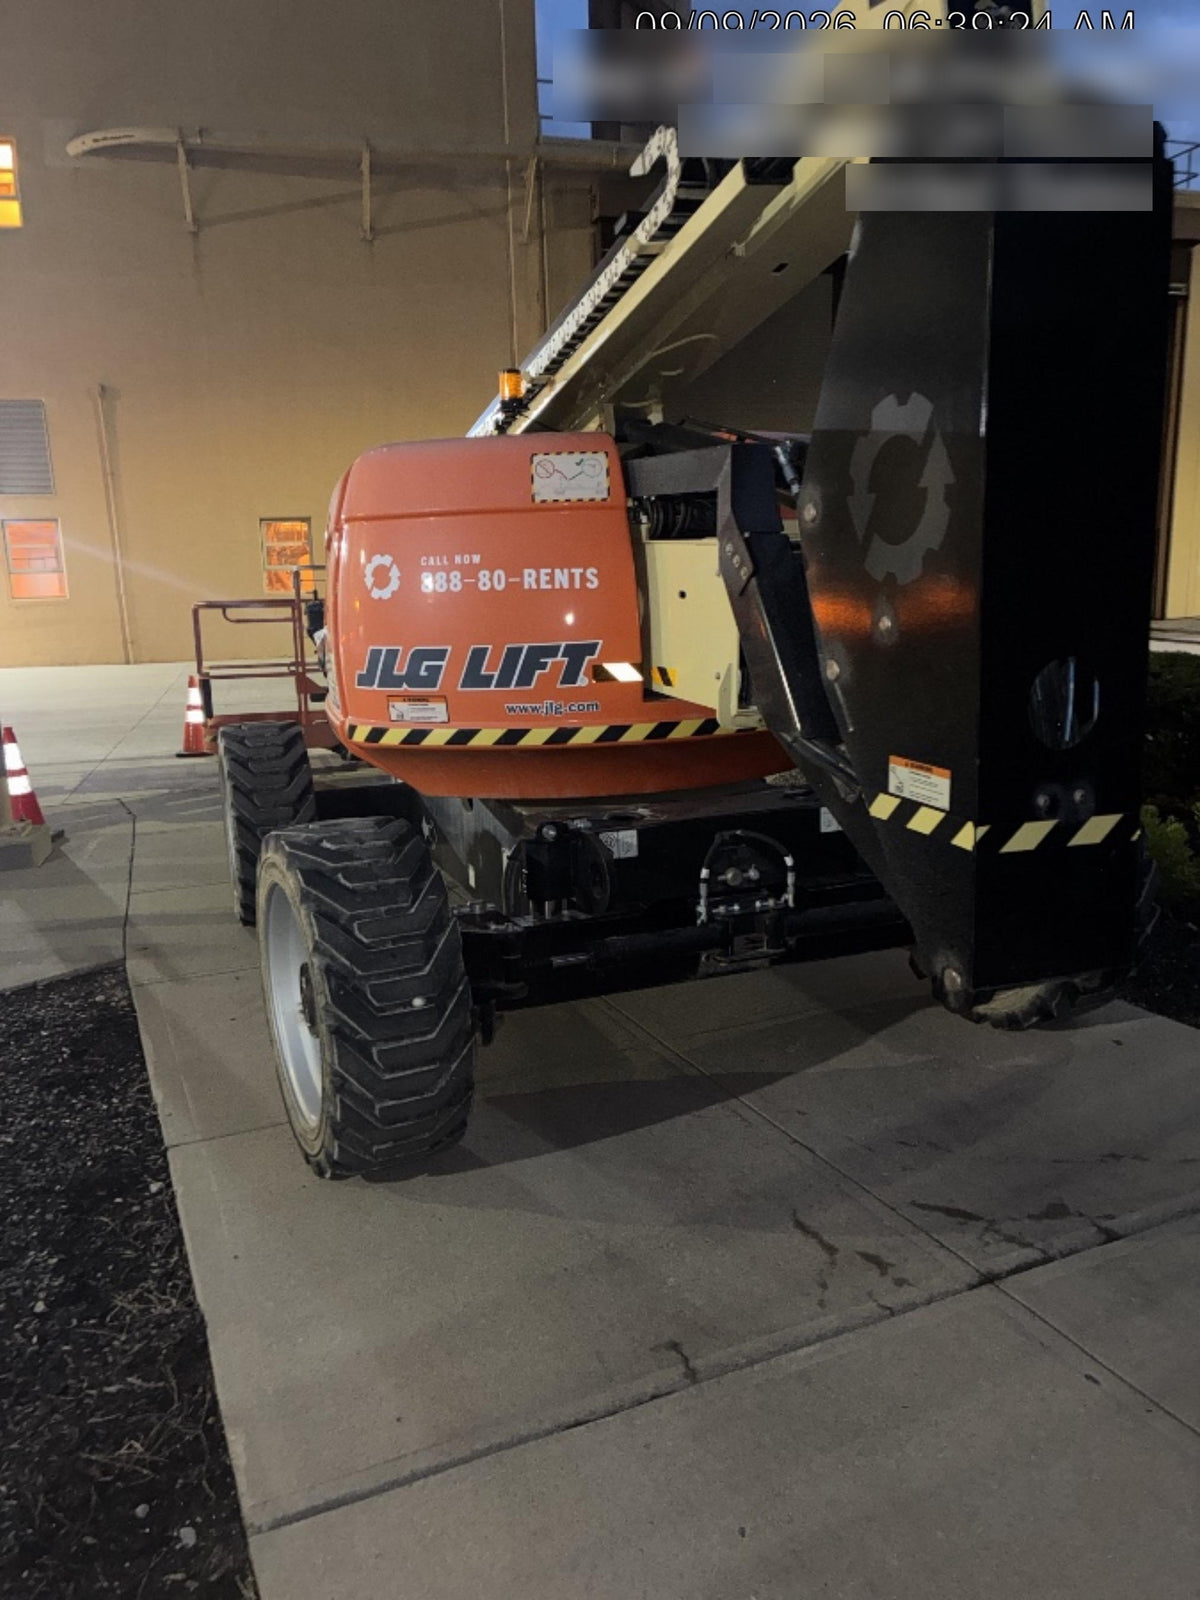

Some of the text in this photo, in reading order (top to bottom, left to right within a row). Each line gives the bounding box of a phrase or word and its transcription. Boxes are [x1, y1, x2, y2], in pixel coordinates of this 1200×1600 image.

[421, 554, 481, 566] CALL NOW
[421, 567, 599, 592] 888-80-RENTS
[355, 640, 603, 691] JLG LIFT
[504, 700, 599, 715] www.jlg.com
